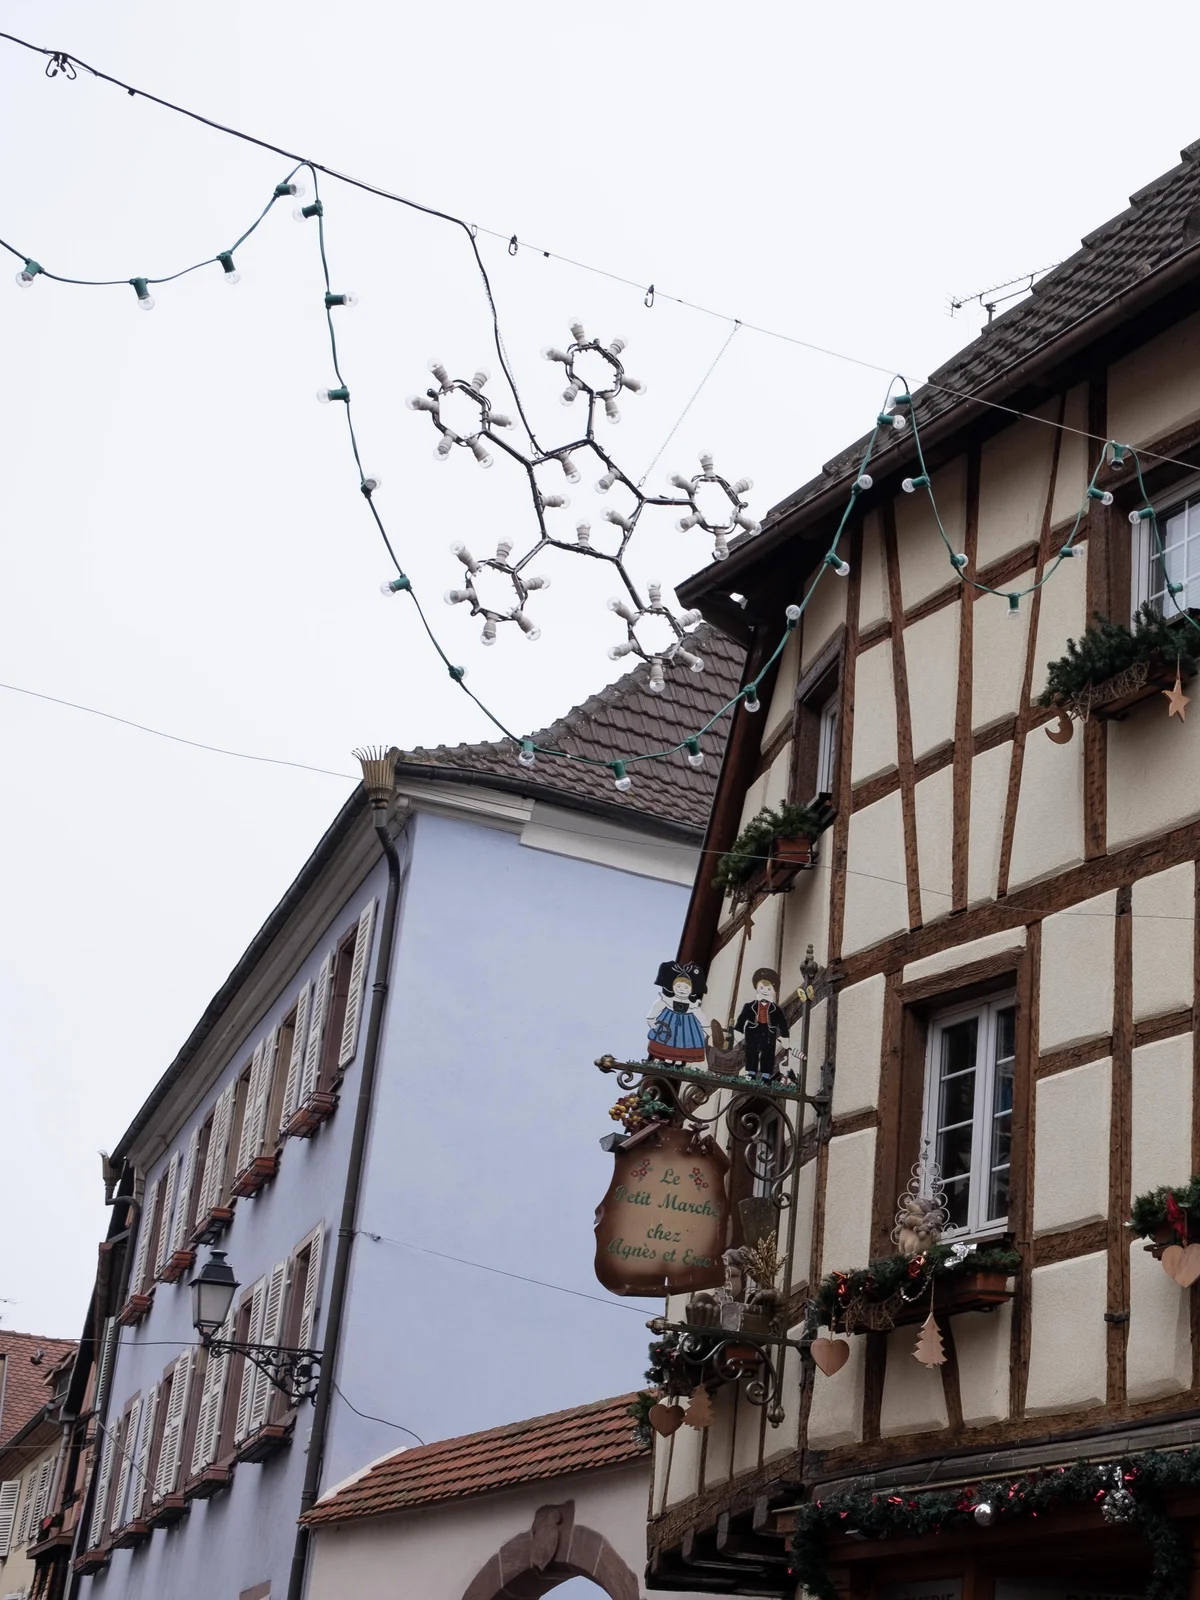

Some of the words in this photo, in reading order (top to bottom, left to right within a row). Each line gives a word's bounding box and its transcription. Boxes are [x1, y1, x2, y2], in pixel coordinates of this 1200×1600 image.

[660, 1168, 681, 1186] Le
[613, 1185, 651, 1206] Petit
[647, 1223, 682, 1242] chez
[608, 1237, 656, 1261] Agnès
[663, 1249, 677, 1262] et
